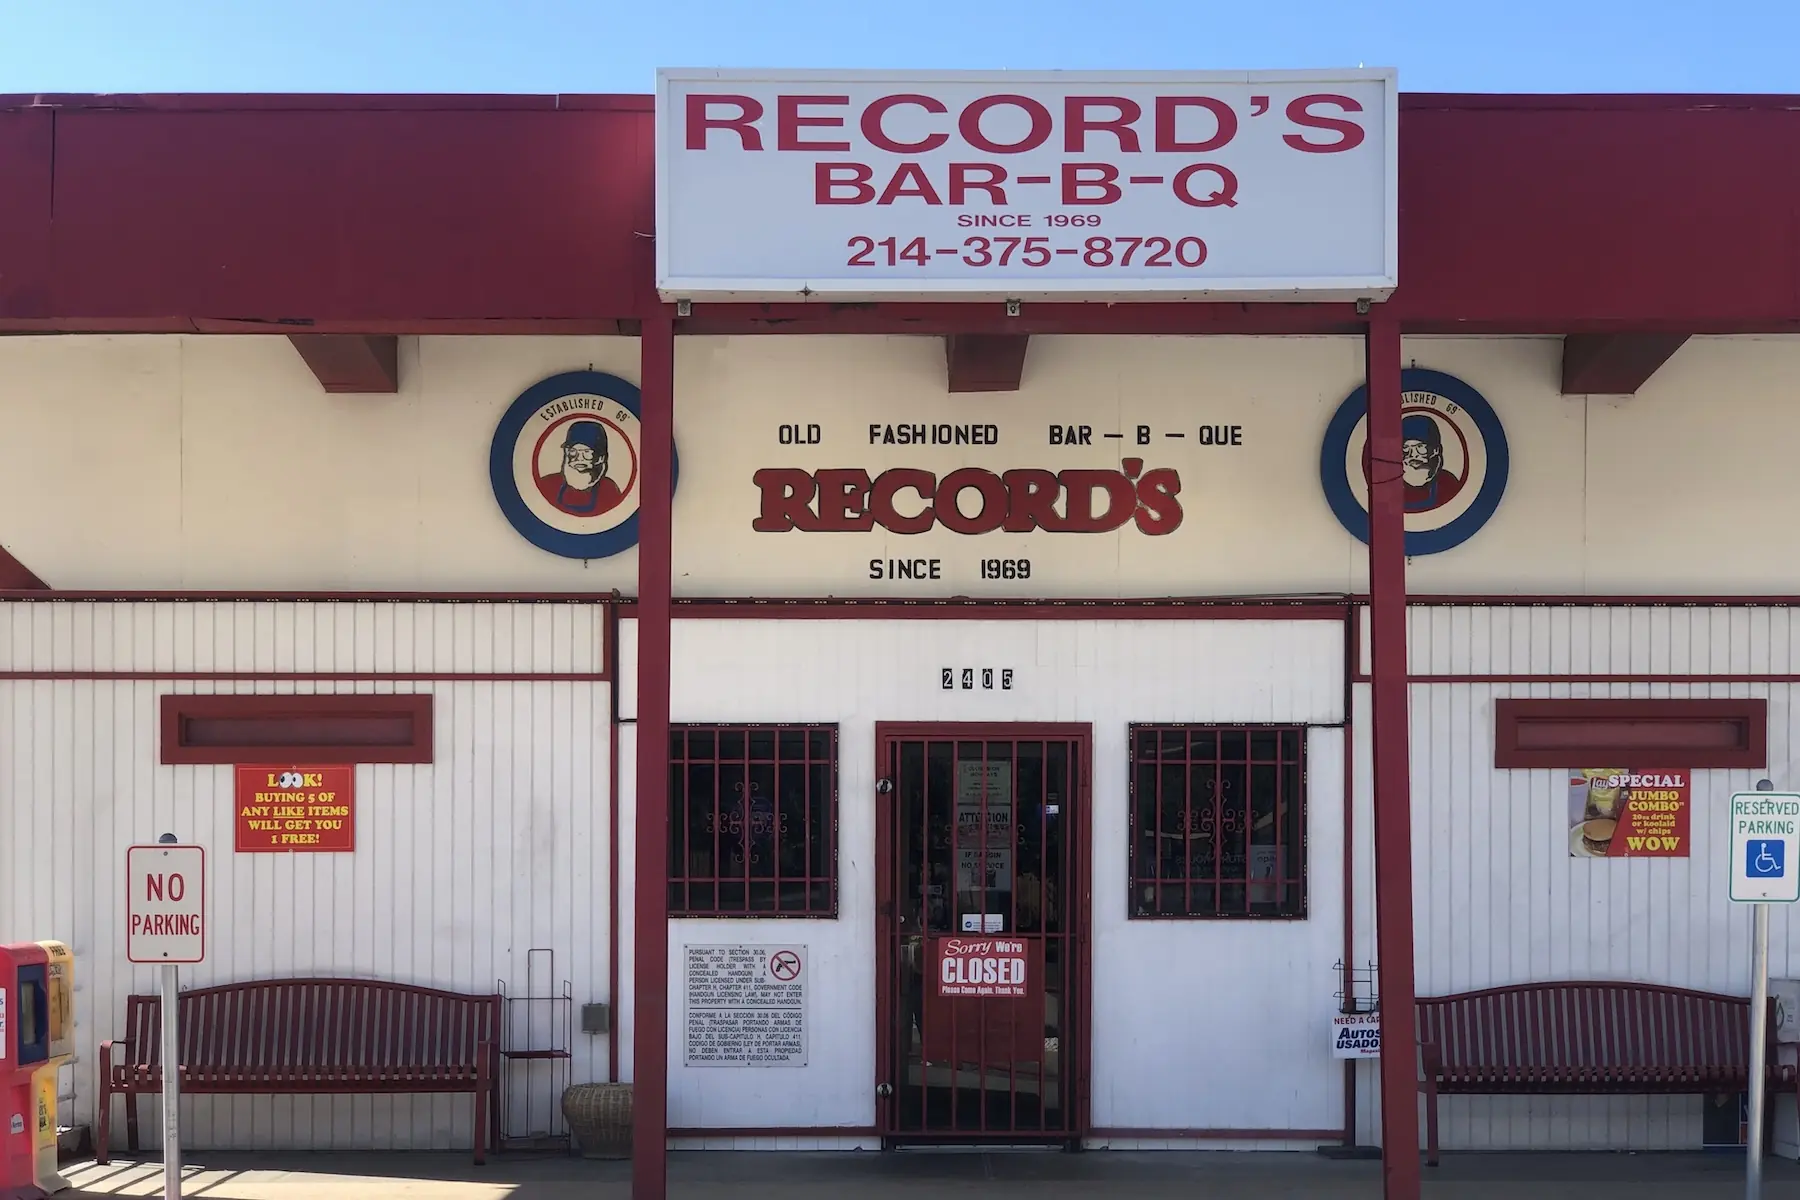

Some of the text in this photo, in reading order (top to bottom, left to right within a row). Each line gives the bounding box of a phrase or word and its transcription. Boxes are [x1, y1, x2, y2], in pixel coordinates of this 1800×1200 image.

[685, 93, 1365, 154] RECORD'S
[815, 162, 1239, 208] BAR-B-Q
[957, 214, 1102, 228] SINCE 1969
[847, 236, 1208, 267] 214-375-8720
[540, 398, 604, 421] ESTABLISHED
[779, 424, 821, 445] OLD
[869, 424, 998, 445] FASHIONED
[752, 458, 1183, 535] RECORD'S
[869, 559, 1031, 579] SINCE 1969
[942, 668, 1013, 690] 2405
[1608, 774, 1685, 788] SPECIAL
[255, 793, 335, 803] BUYING 5 OF
[241, 806, 349, 816] ANY LIKE ITEMS
[1735, 802, 1800, 816] RESERVED
[959, 812, 1008, 822] ATTETION
[248, 820, 342, 830] WILL GET YOU
[1648, 828, 1671, 836] chips
[1738, 821, 1794, 834] PARKING
[271, 834, 320, 844] 1 FREE!
[1626, 837, 1680, 851] WOW
[147, 873, 185, 902] NO
[132, 914, 200, 935] PARKING
[944, 940, 1022, 956] Sorry We're
[942, 957, 1025, 984] CLOSED
[1359, 1016, 1364, 1024] A
[1336, 1039, 1380, 1049] USADO
